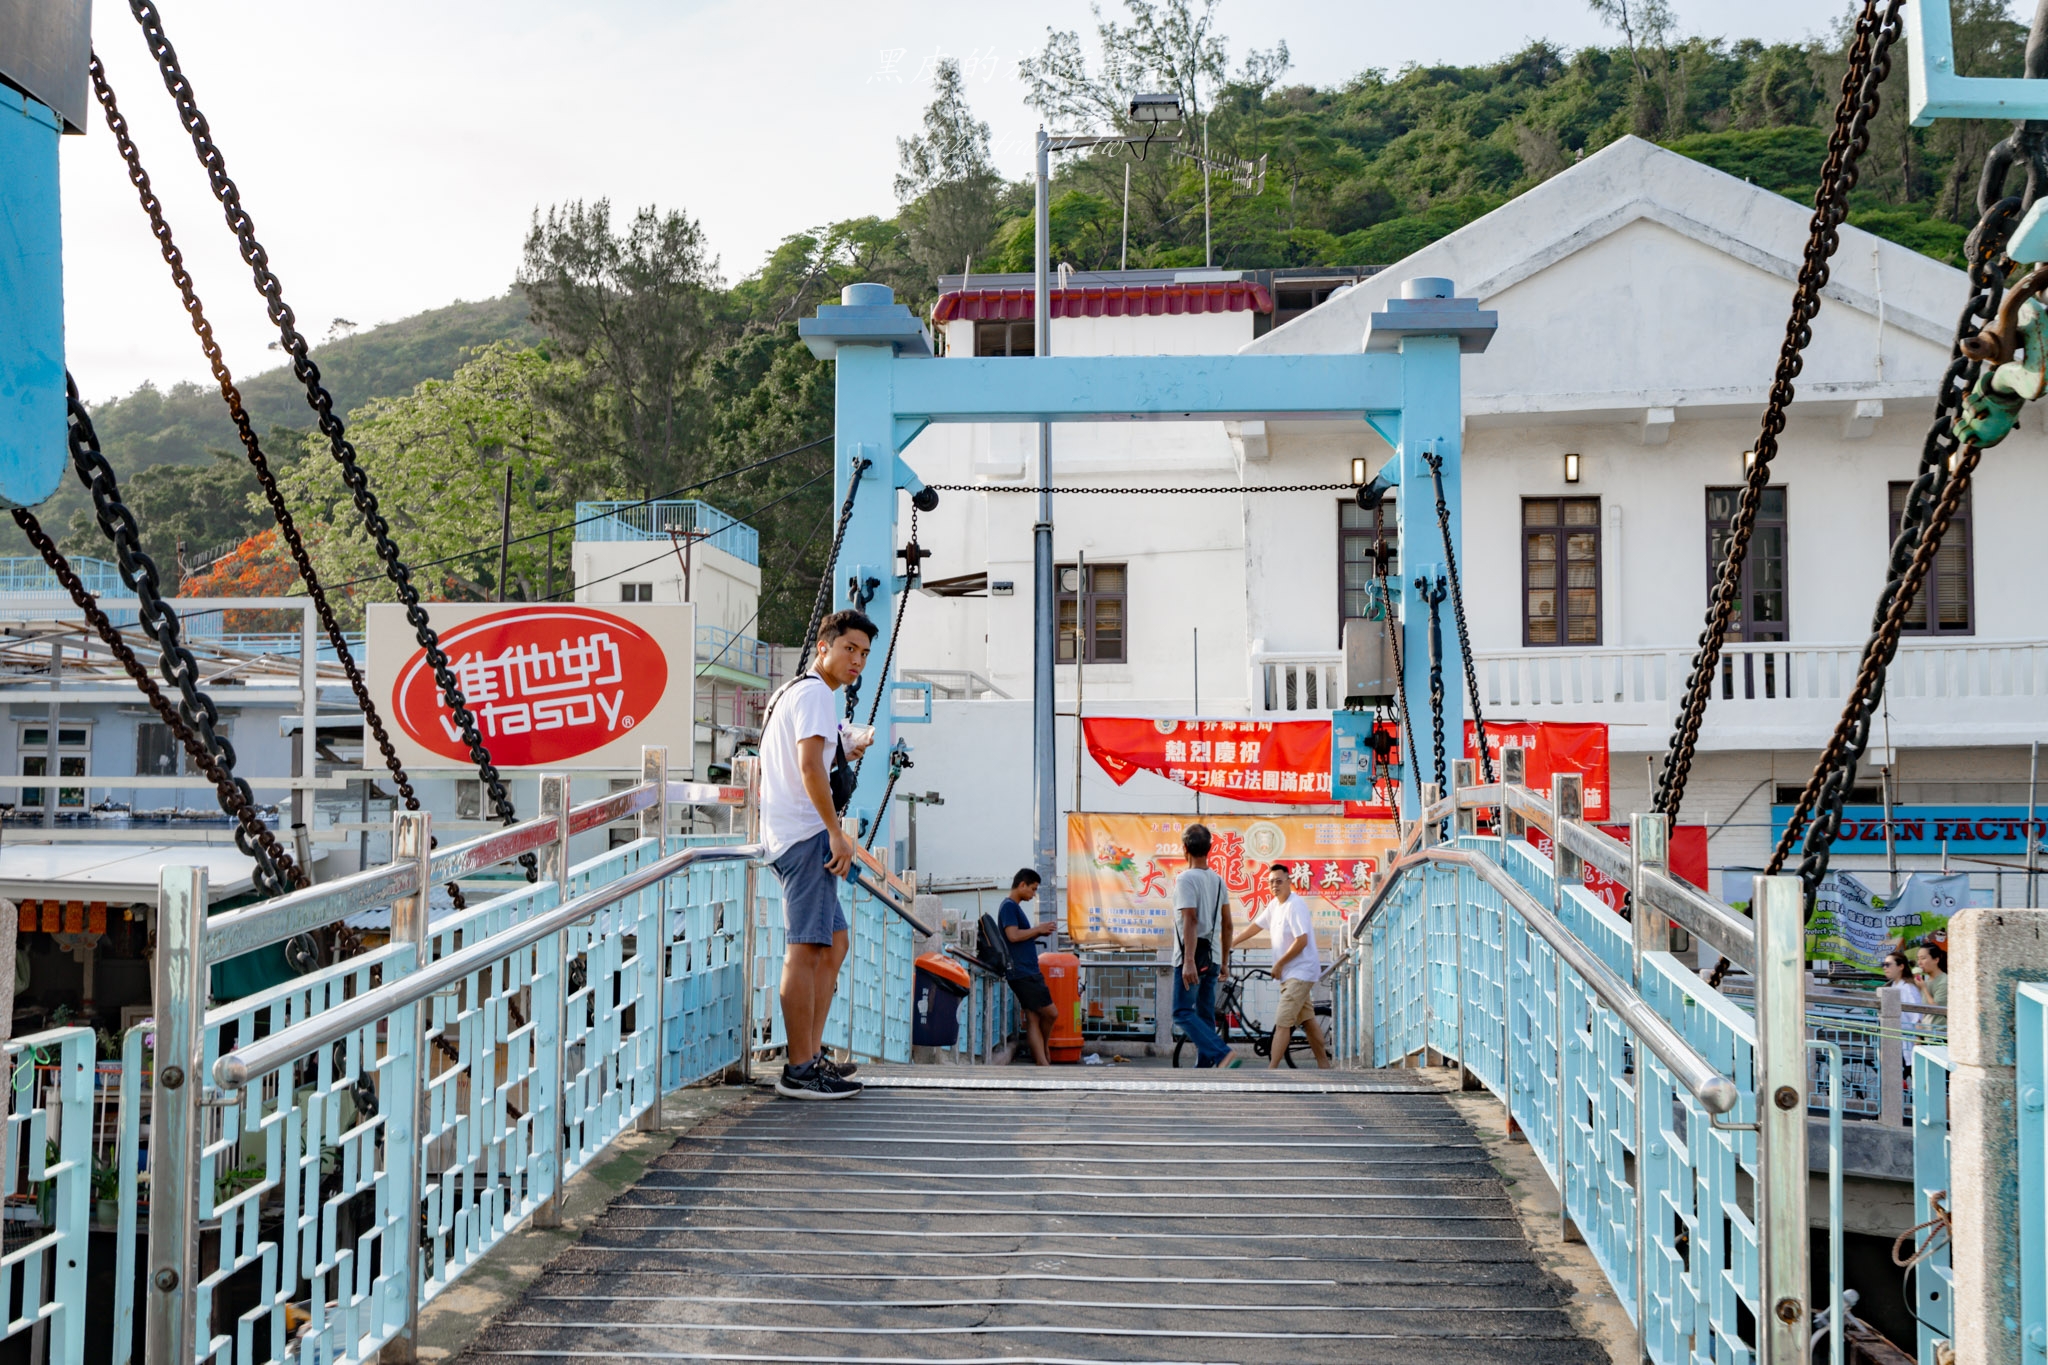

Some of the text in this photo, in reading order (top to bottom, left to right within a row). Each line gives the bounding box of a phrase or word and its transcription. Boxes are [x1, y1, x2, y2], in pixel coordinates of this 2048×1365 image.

[434, 632, 622, 708] 維他奶
[439, 689, 624, 743] vitasoy
[1165, 740, 1261, 763] 熱烈慶祝
[1793, 818, 1926, 841] OZEN
[1289, 861, 1371, 891] 精英賽
